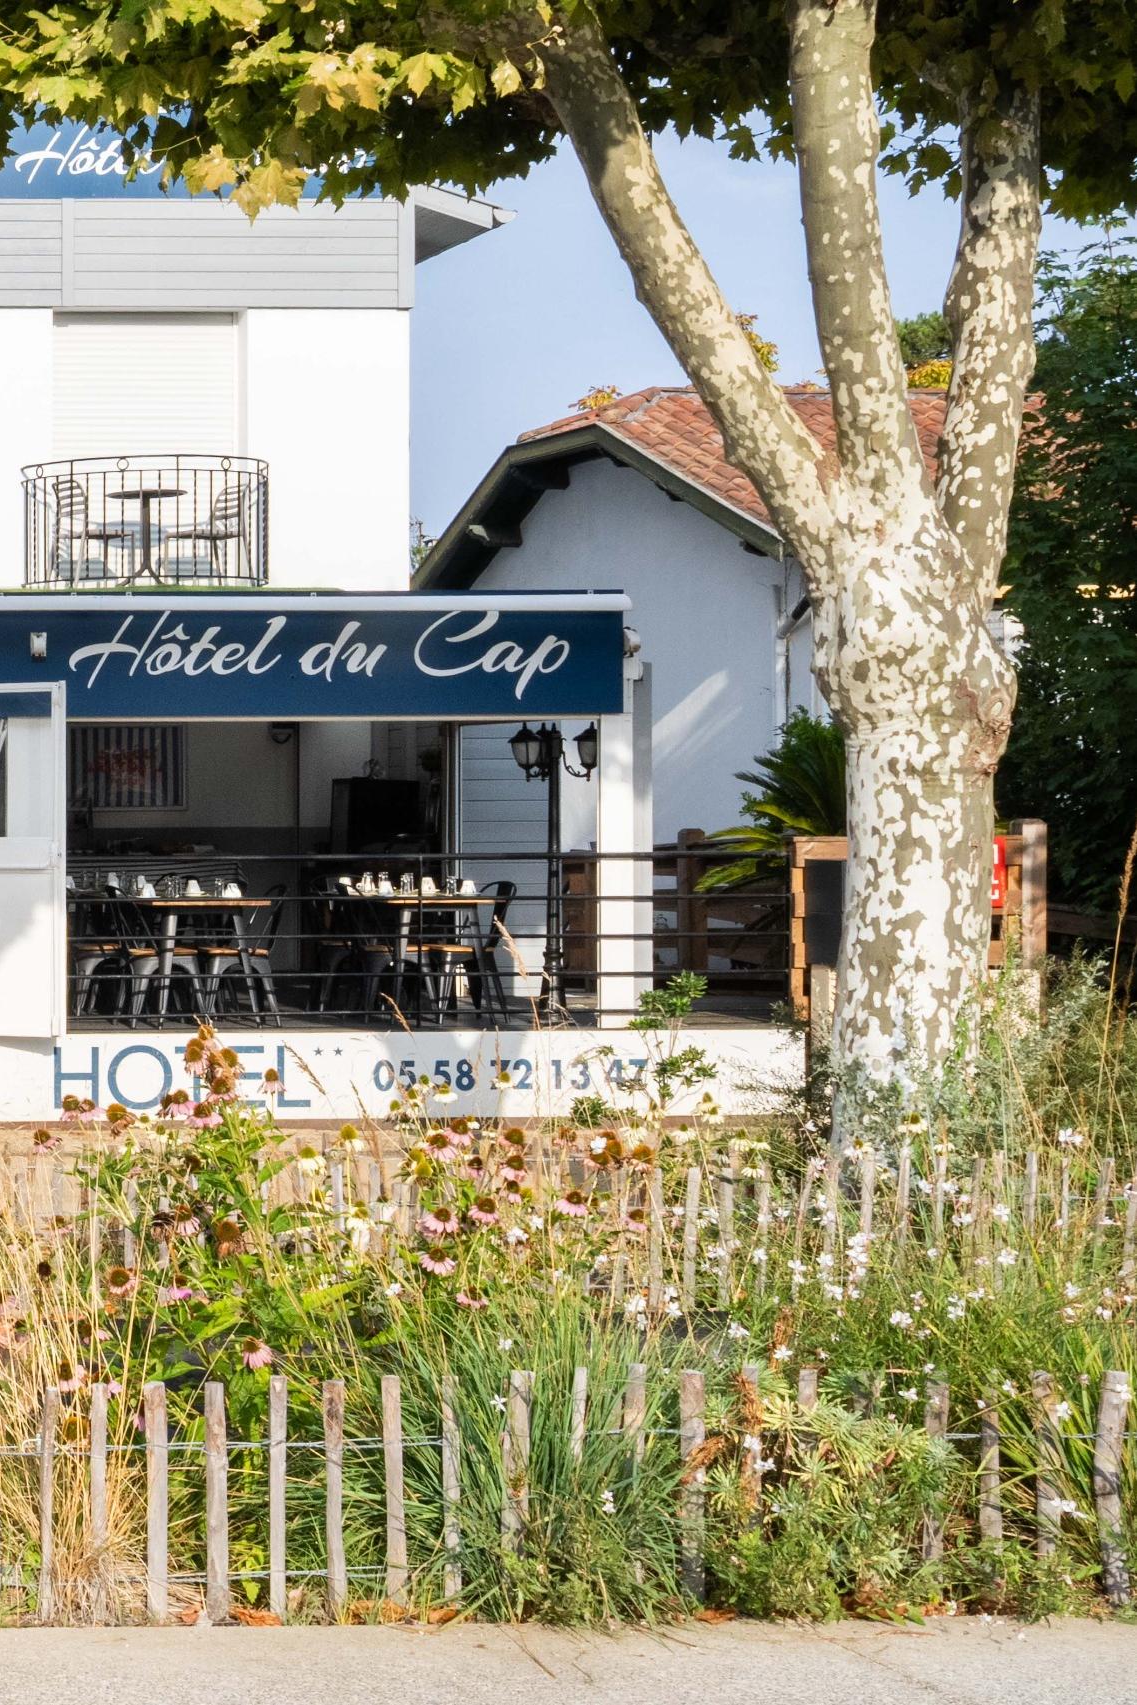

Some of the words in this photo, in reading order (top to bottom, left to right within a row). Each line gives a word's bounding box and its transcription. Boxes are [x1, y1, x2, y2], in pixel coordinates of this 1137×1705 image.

[14, 124, 166, 185] Hôt
[68, 610, 287, 689] Hôtel
[298, 620, 389, 682] du
[414, 610, 571, 700] Cap
[374, 1059, 417, 1092] 05
[434, 1058, 476, 1092] 58
[490, 1058, 533, 1090] 72
[551, 1059, 591, 1090] 13
[605, 1058, 649, 1090] 47
